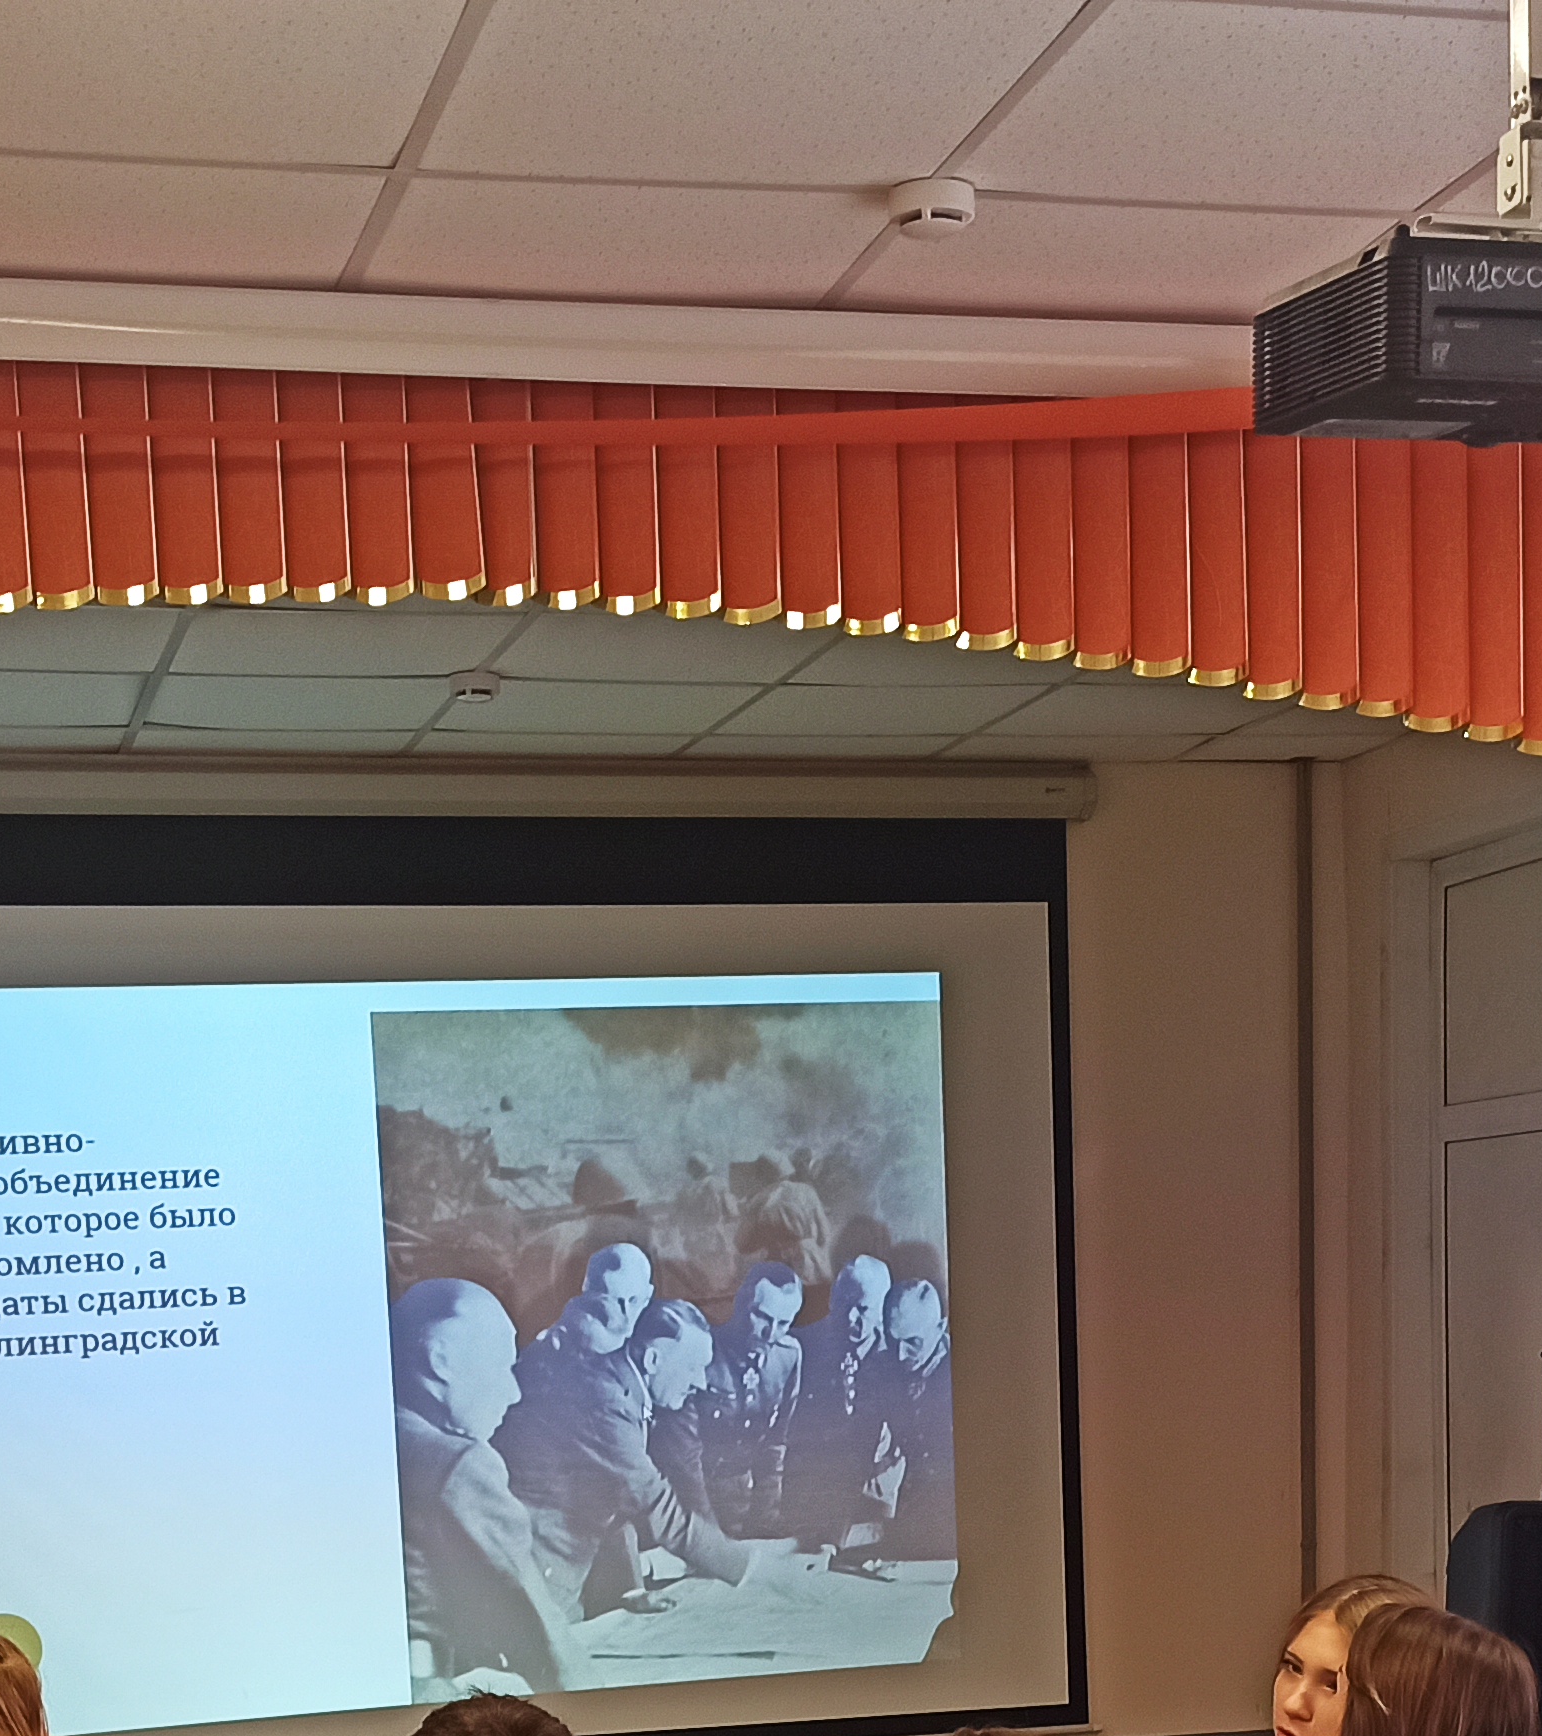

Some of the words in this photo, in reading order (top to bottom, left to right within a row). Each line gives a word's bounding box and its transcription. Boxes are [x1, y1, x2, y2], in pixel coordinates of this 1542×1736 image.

[2, 1210, 140, 1239] которое
[149, 1202, 236, 1230] было
[149, 1250, 167, 1270] а
[77, 1287, 218, 1316] сдались
[226, 1285, 247, 1306] в
